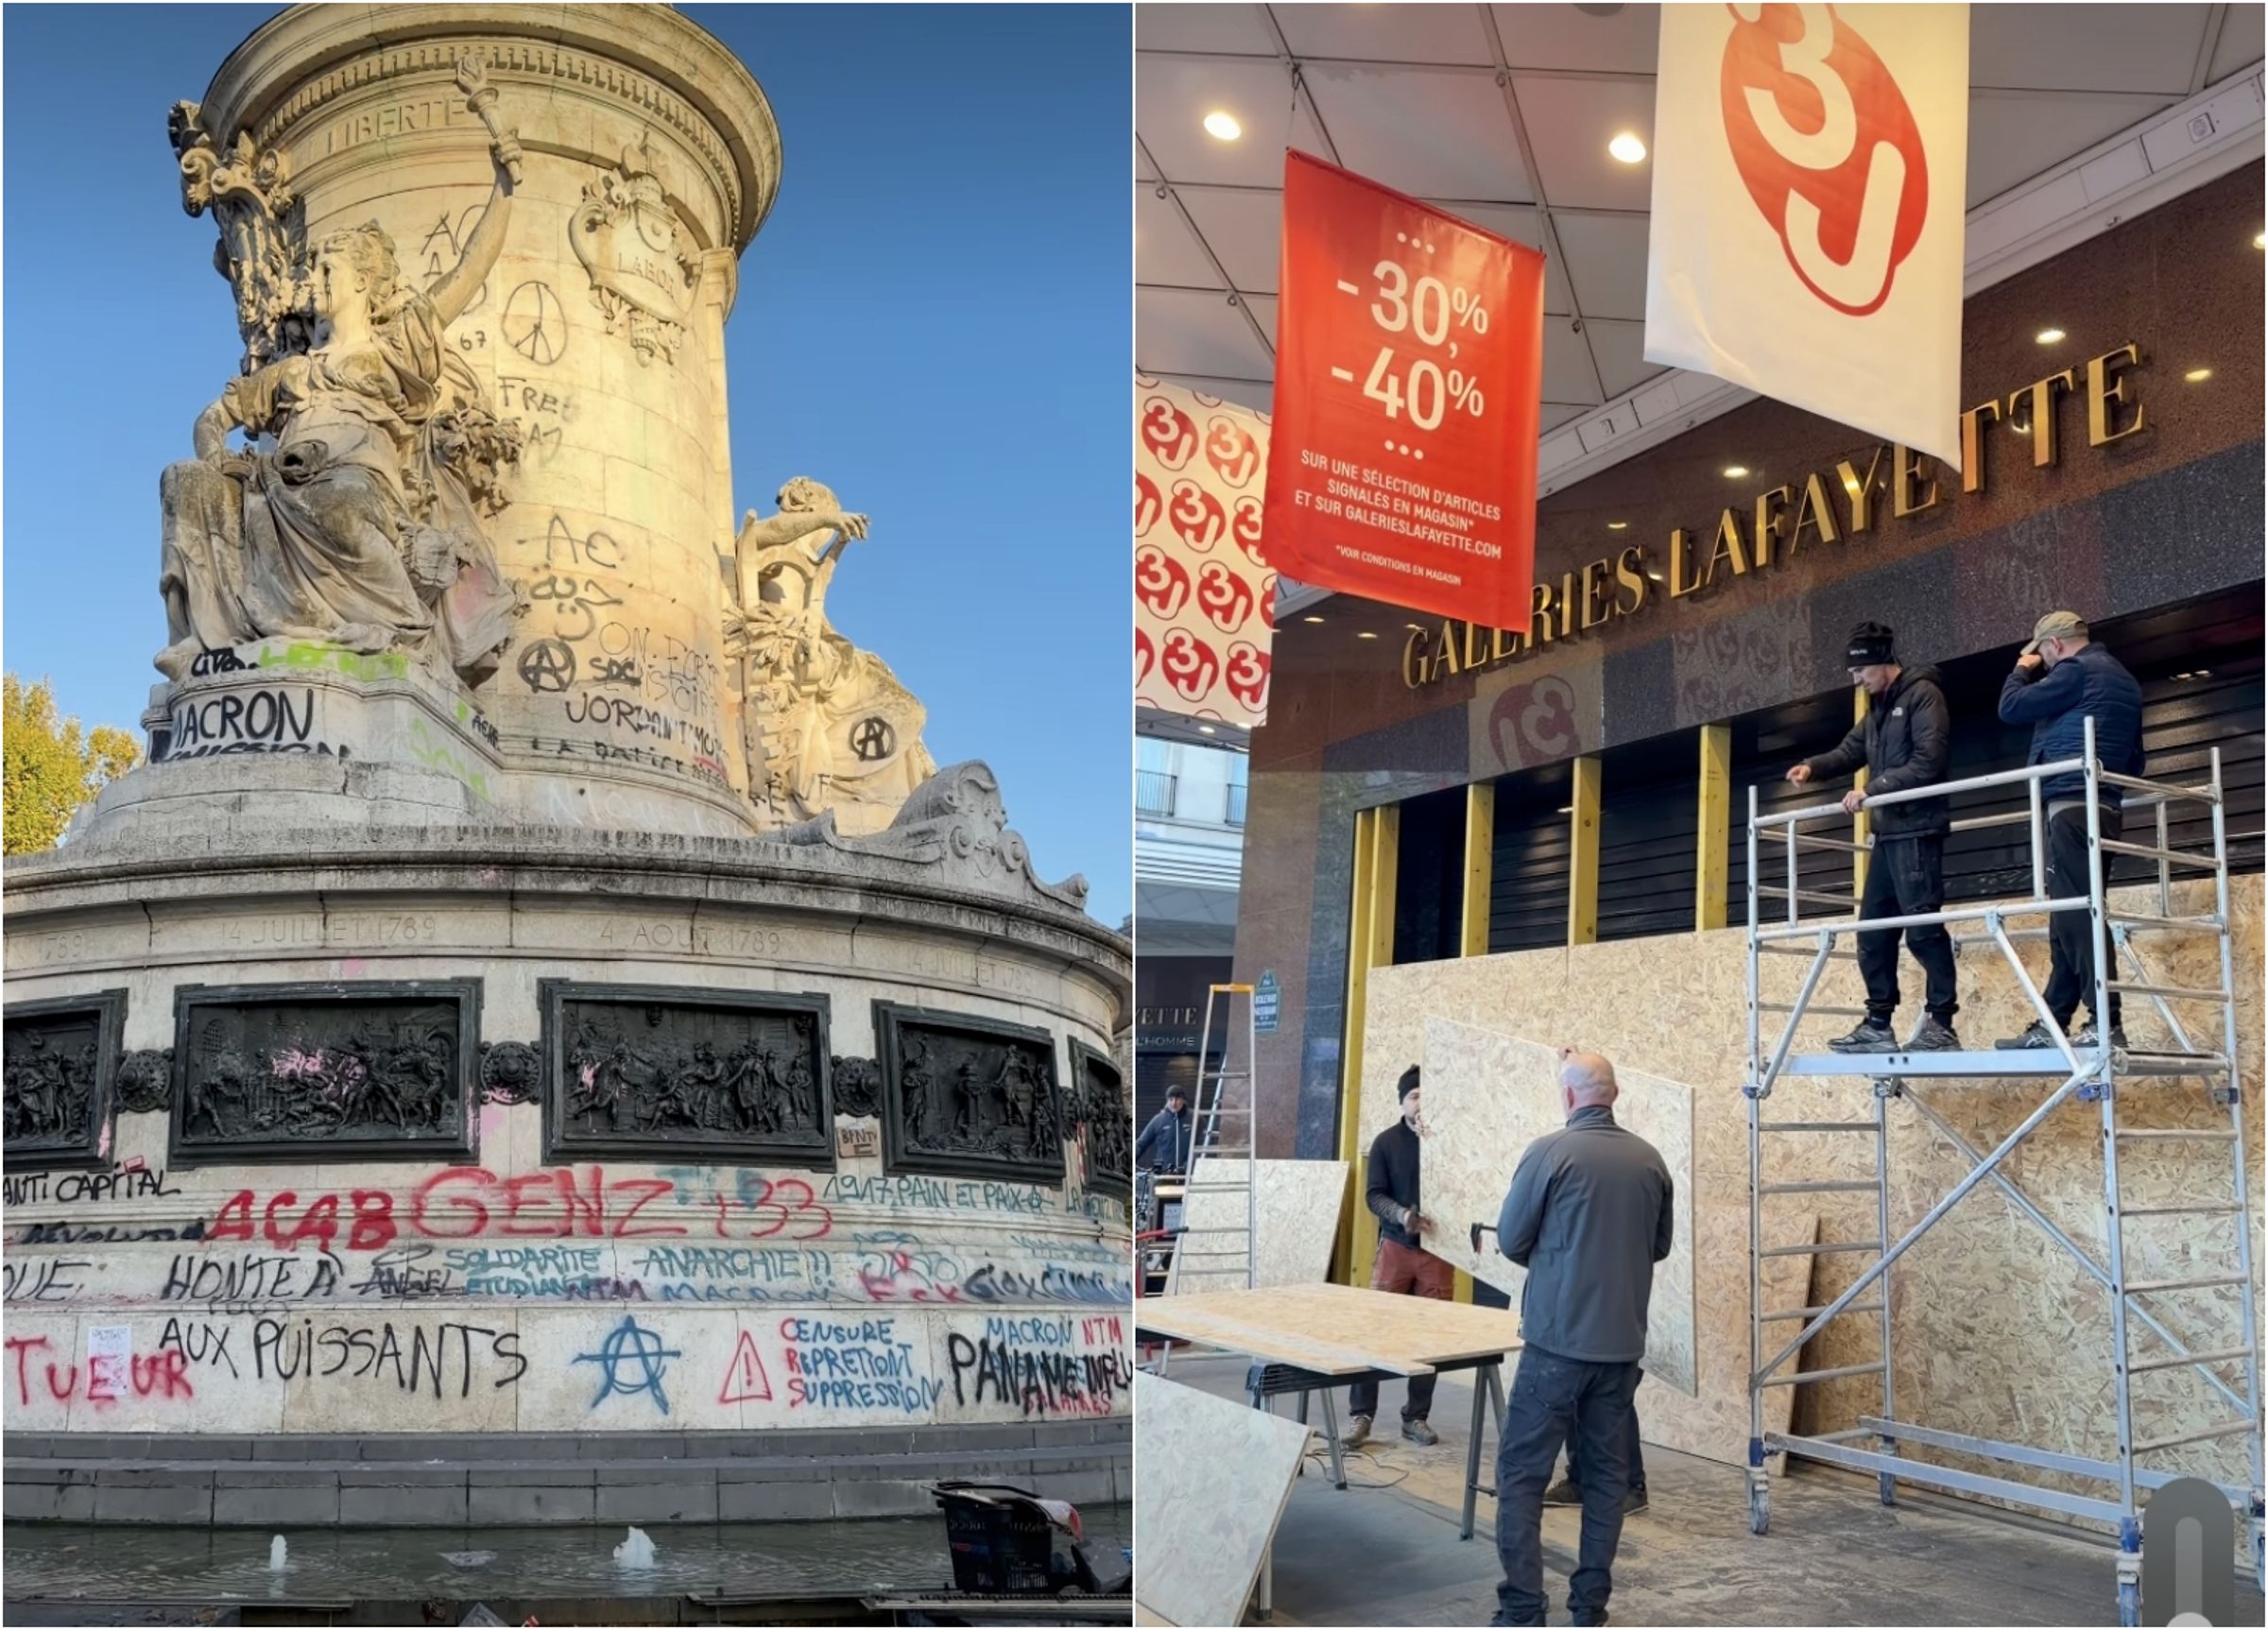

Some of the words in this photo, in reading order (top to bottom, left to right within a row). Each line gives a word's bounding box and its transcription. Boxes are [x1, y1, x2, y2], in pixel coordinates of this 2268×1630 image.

[1301, 450, 1328, 472] SUR
[1332, 460, 1358, 480] UNE
[1363, 468, 1430, 501] SÉLECTION
[1434, 489, 1501, 521] D'ARTICLES
[1670, 340, 2145, 598] LAFAYETTE
[1328, 479, 1389, 509] SIGNALÉS
[1394, 498, 1410, 515] EN
[1295, 489, 1312, 506] ET
[1315, 496, 1342, 517] SUR
[1346, 506, 1502, 559] GALERIESLAFAYETTE.COM
[1362, 550, 1411, 574] CONDITIONS
[1413, 564, 1424, 576] EN
[1426, 569, 1462, 586] MAGASIN
[378, 915, 438, 943] 1789
[56, 1161, 181, 1202] CAPITAL
[897, 1175, 951, 1209] PAIN
[956, 1182, 980, 1209] ET
[204, 1190, 399, 1250] ACAB
[161, 1254, 302, 1301] HONTE
[632, 1246, 801, 1281] ANARCHIE
[780, 1317, 895, 1346] CENSURE
[986, 1316, 1074, 1347] MACRON
[1081, 1315, 1124, 1347] NTM
[5, 1335, 195, 1407] TUEUR
[159, 1316, 240, 1381] AUX
[251, 1319, 528, 1400] PUISSANTS
[787, 1375, 944, 1414] SUPPRESSION
